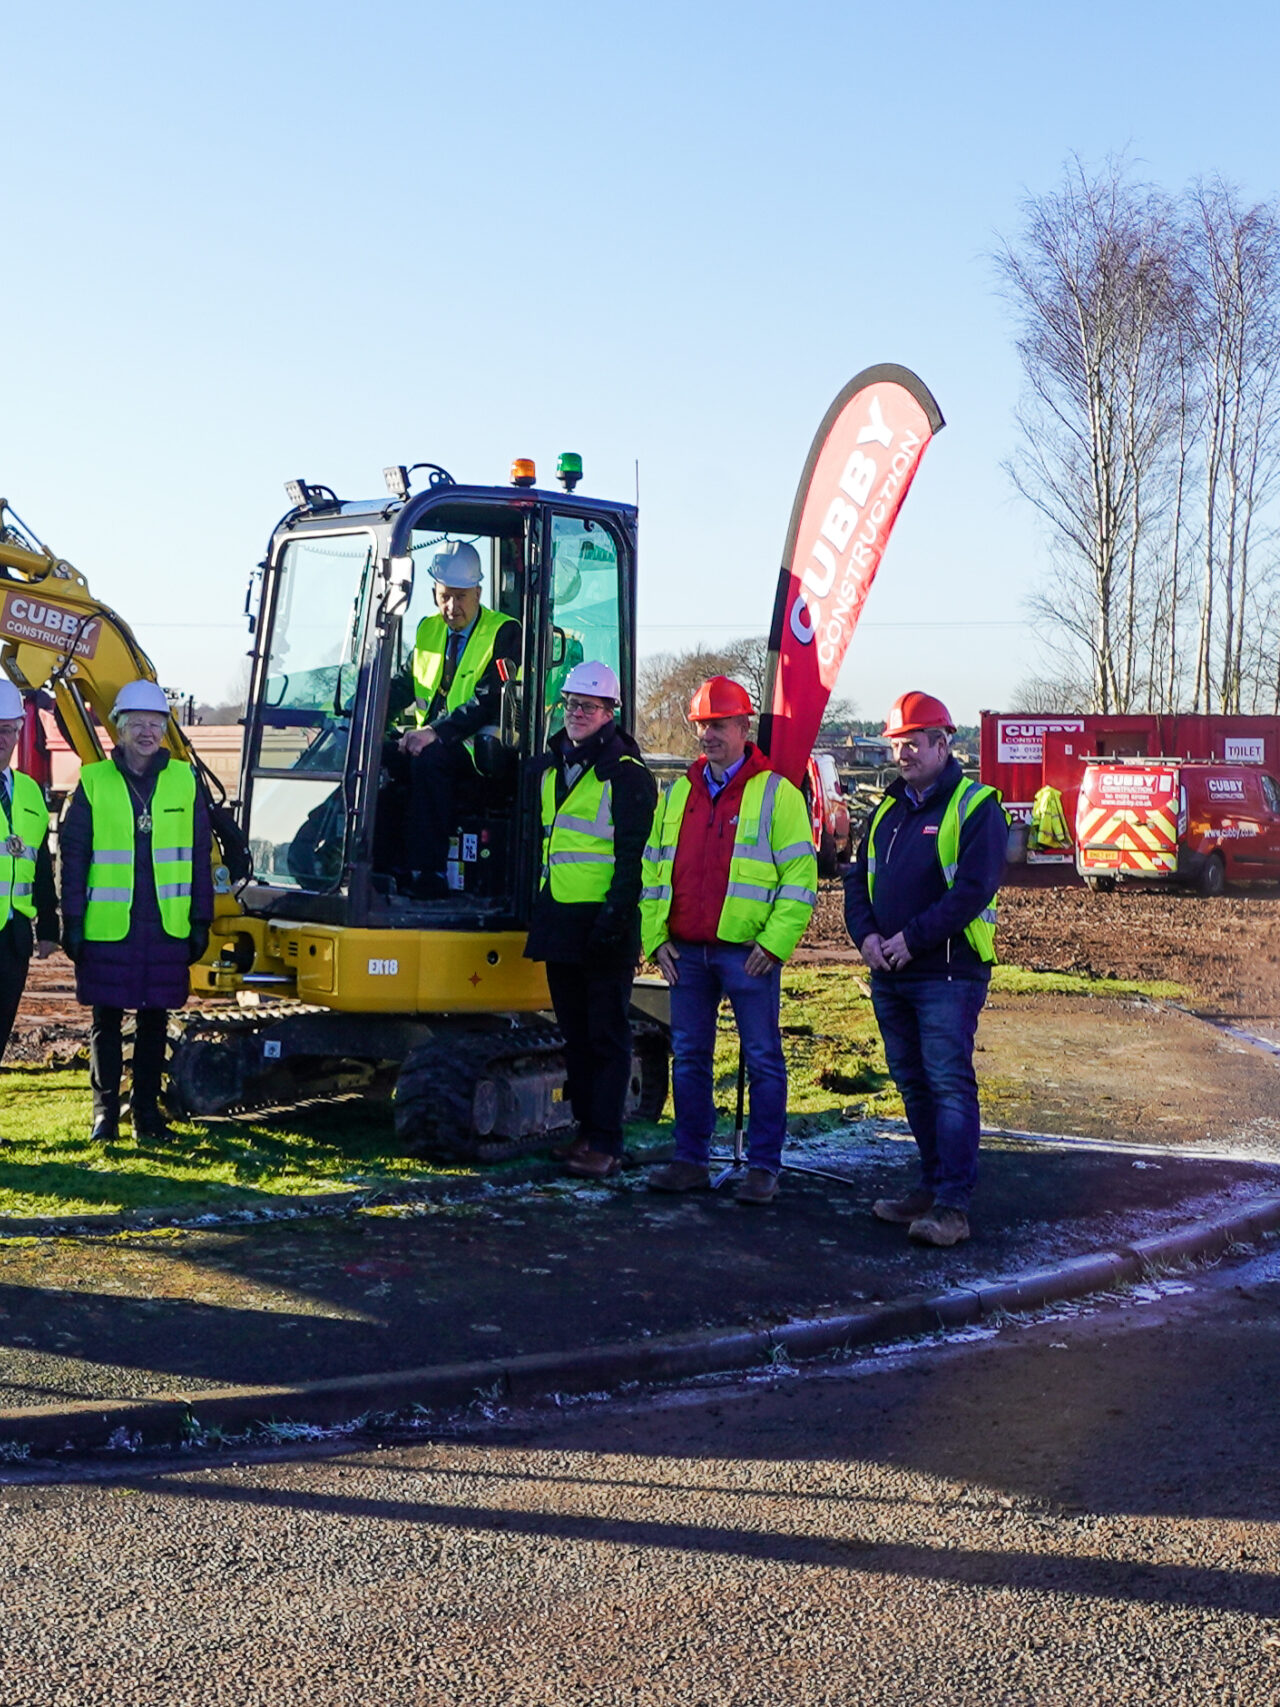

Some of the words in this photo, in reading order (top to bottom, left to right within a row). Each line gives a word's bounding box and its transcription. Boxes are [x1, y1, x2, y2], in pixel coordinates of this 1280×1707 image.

[789, 395, 895, 646] CUBBY
[817, 428, 921, 666] CONSTRUCTION
[10, 598, 97, 640] CUBBY
[6, 620, 91, 655] CONSTRUCTION
[1228, 745, 1261, 757] TOILET
[1102, 775, 1156, 787] CUBBY
[1208, 779, 1243, 792] CUBBY
